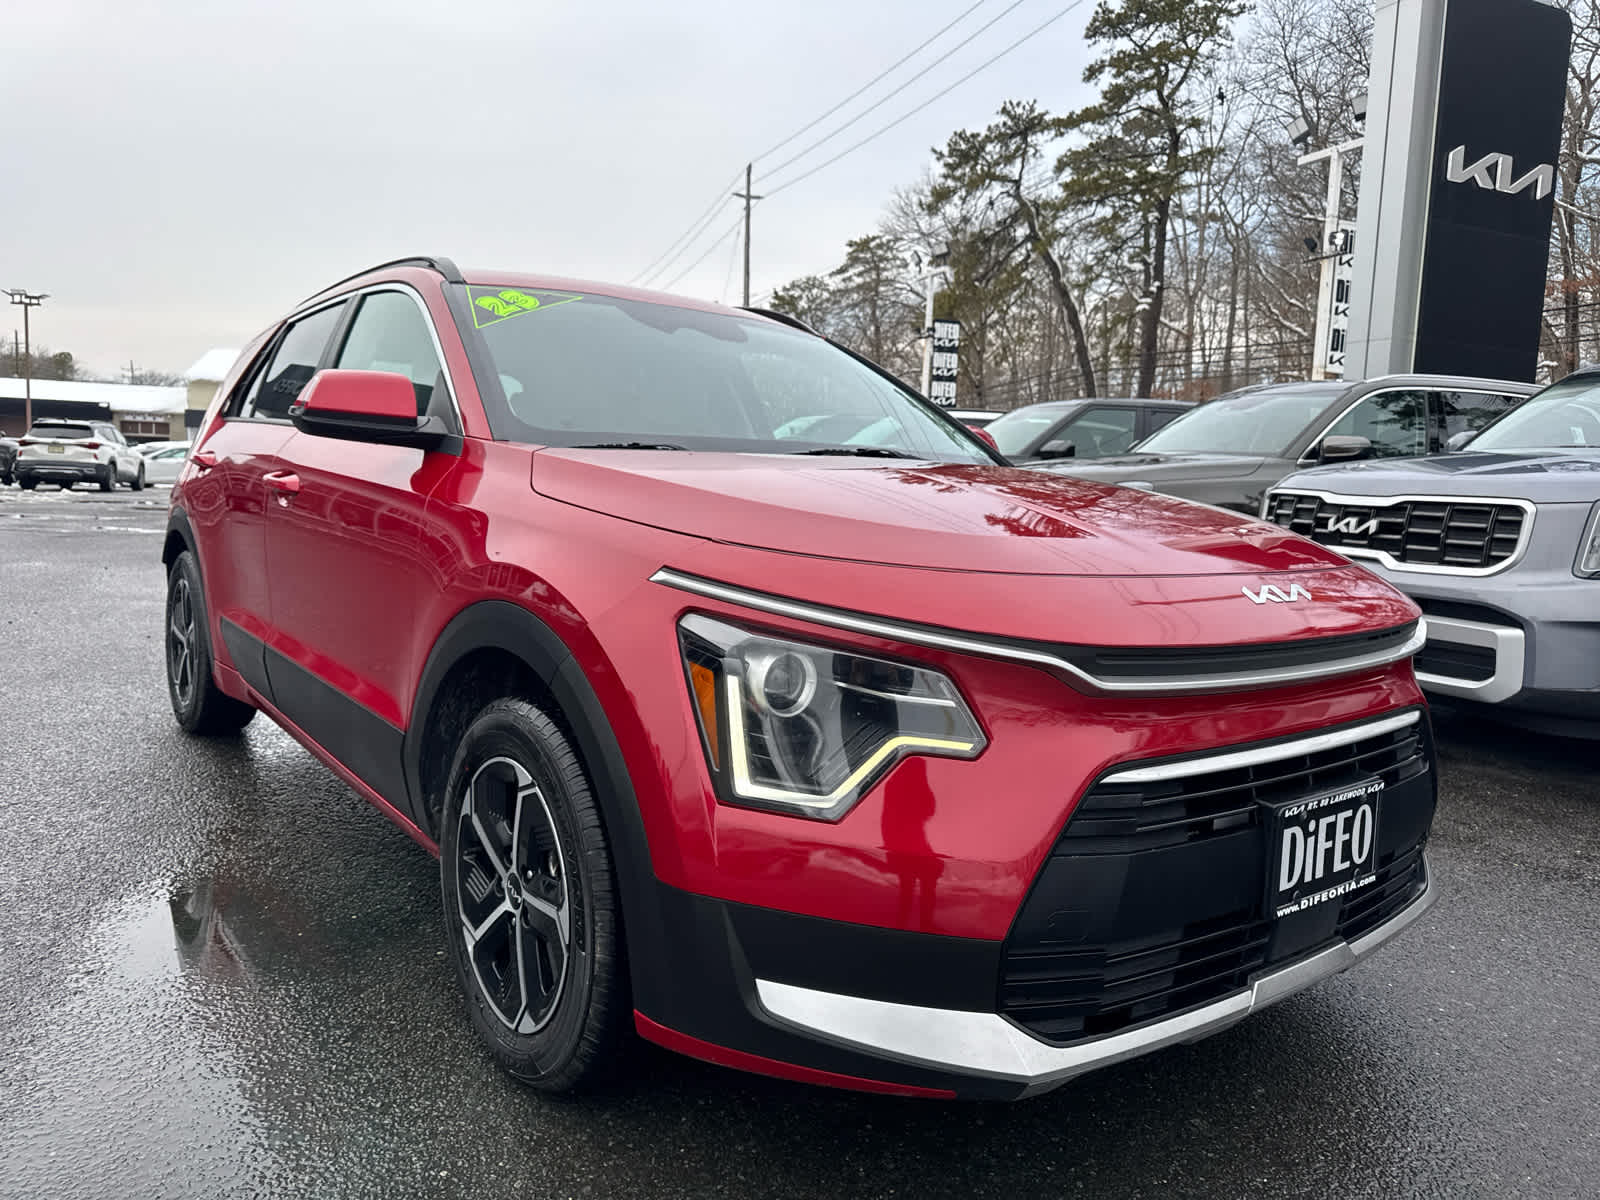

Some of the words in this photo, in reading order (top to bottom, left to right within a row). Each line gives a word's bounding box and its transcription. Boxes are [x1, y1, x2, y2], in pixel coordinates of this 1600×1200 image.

[1447, 144, 1554, 200] KIA
[1327, 515, 1378, 535] KIA
[1241, 583, 1312, 605] KIA
[1284, 804, 1305, 818] KIA
[1330, 788, 1366, 804] LAKEWOOD
[1367, 782, 1385, 794] KIA
[1276, 875, 1377, 918] www.DIFEOKIA.com
